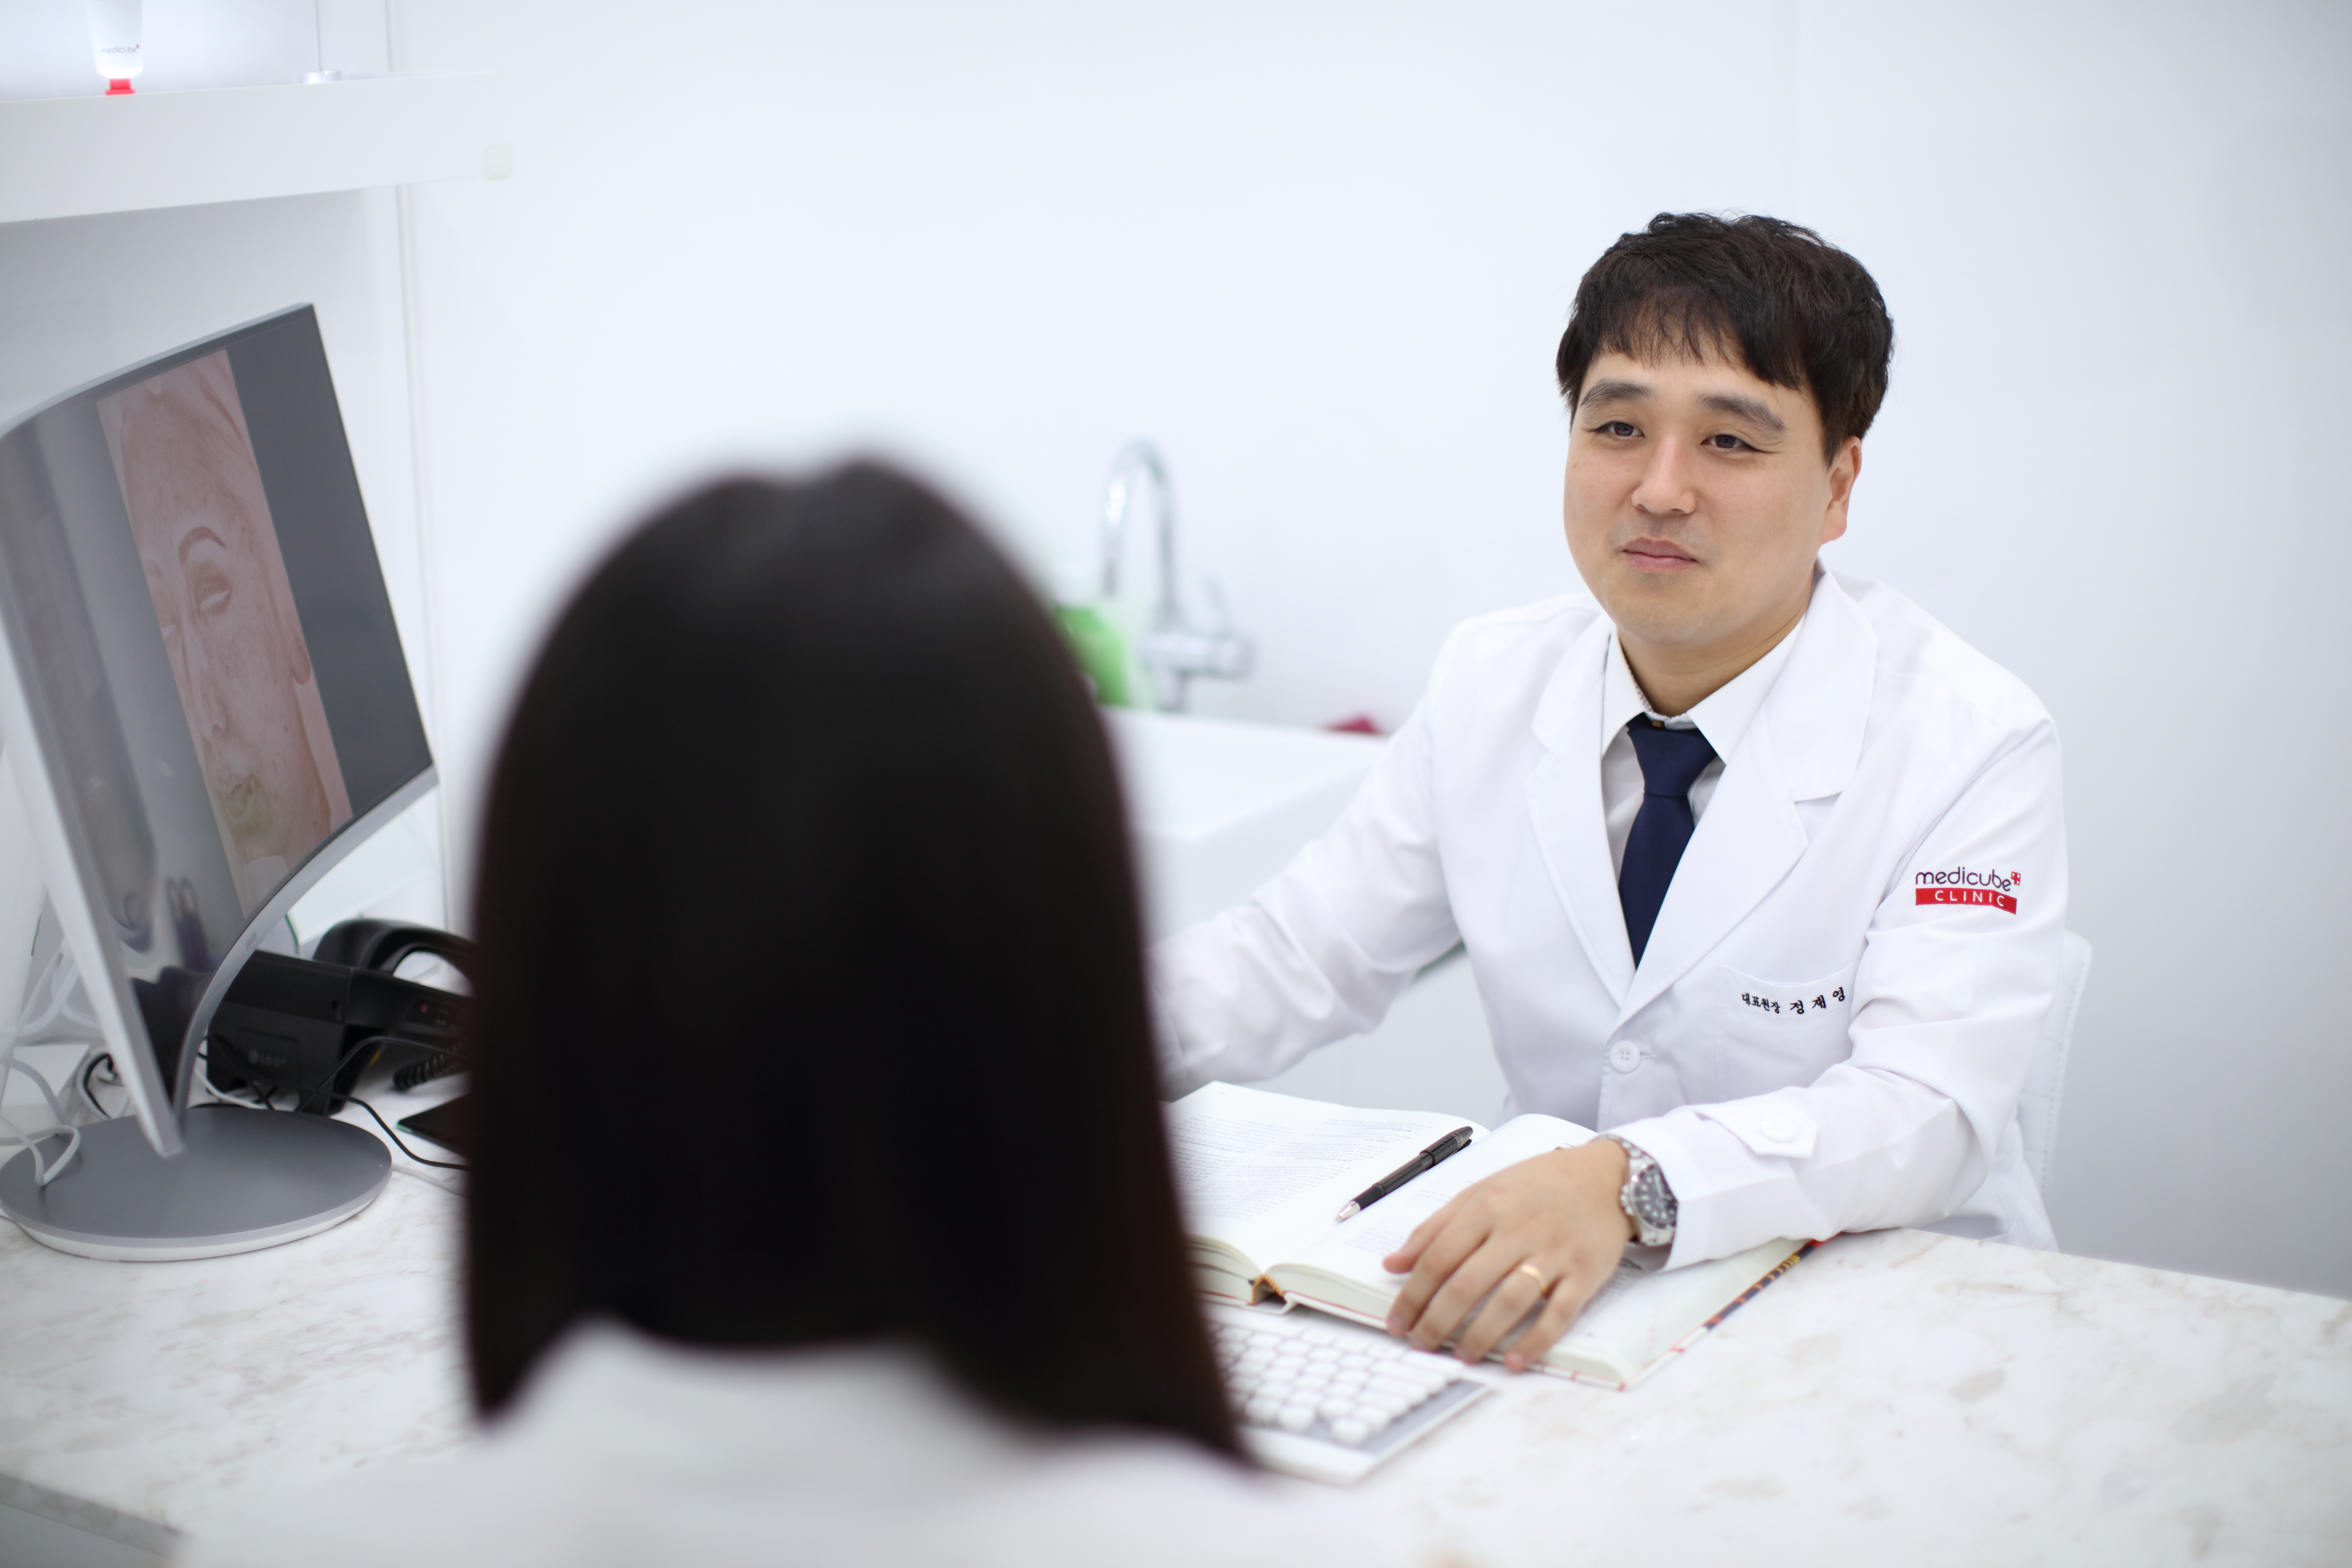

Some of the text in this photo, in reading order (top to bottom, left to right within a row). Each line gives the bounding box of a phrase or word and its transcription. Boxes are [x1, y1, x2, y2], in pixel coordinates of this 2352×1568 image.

[1916, 867, 2012, 892] medicube
[1935, 890, 2004, 907] CLINIC
[1742, 993, 1781, 1013] 대표원장
